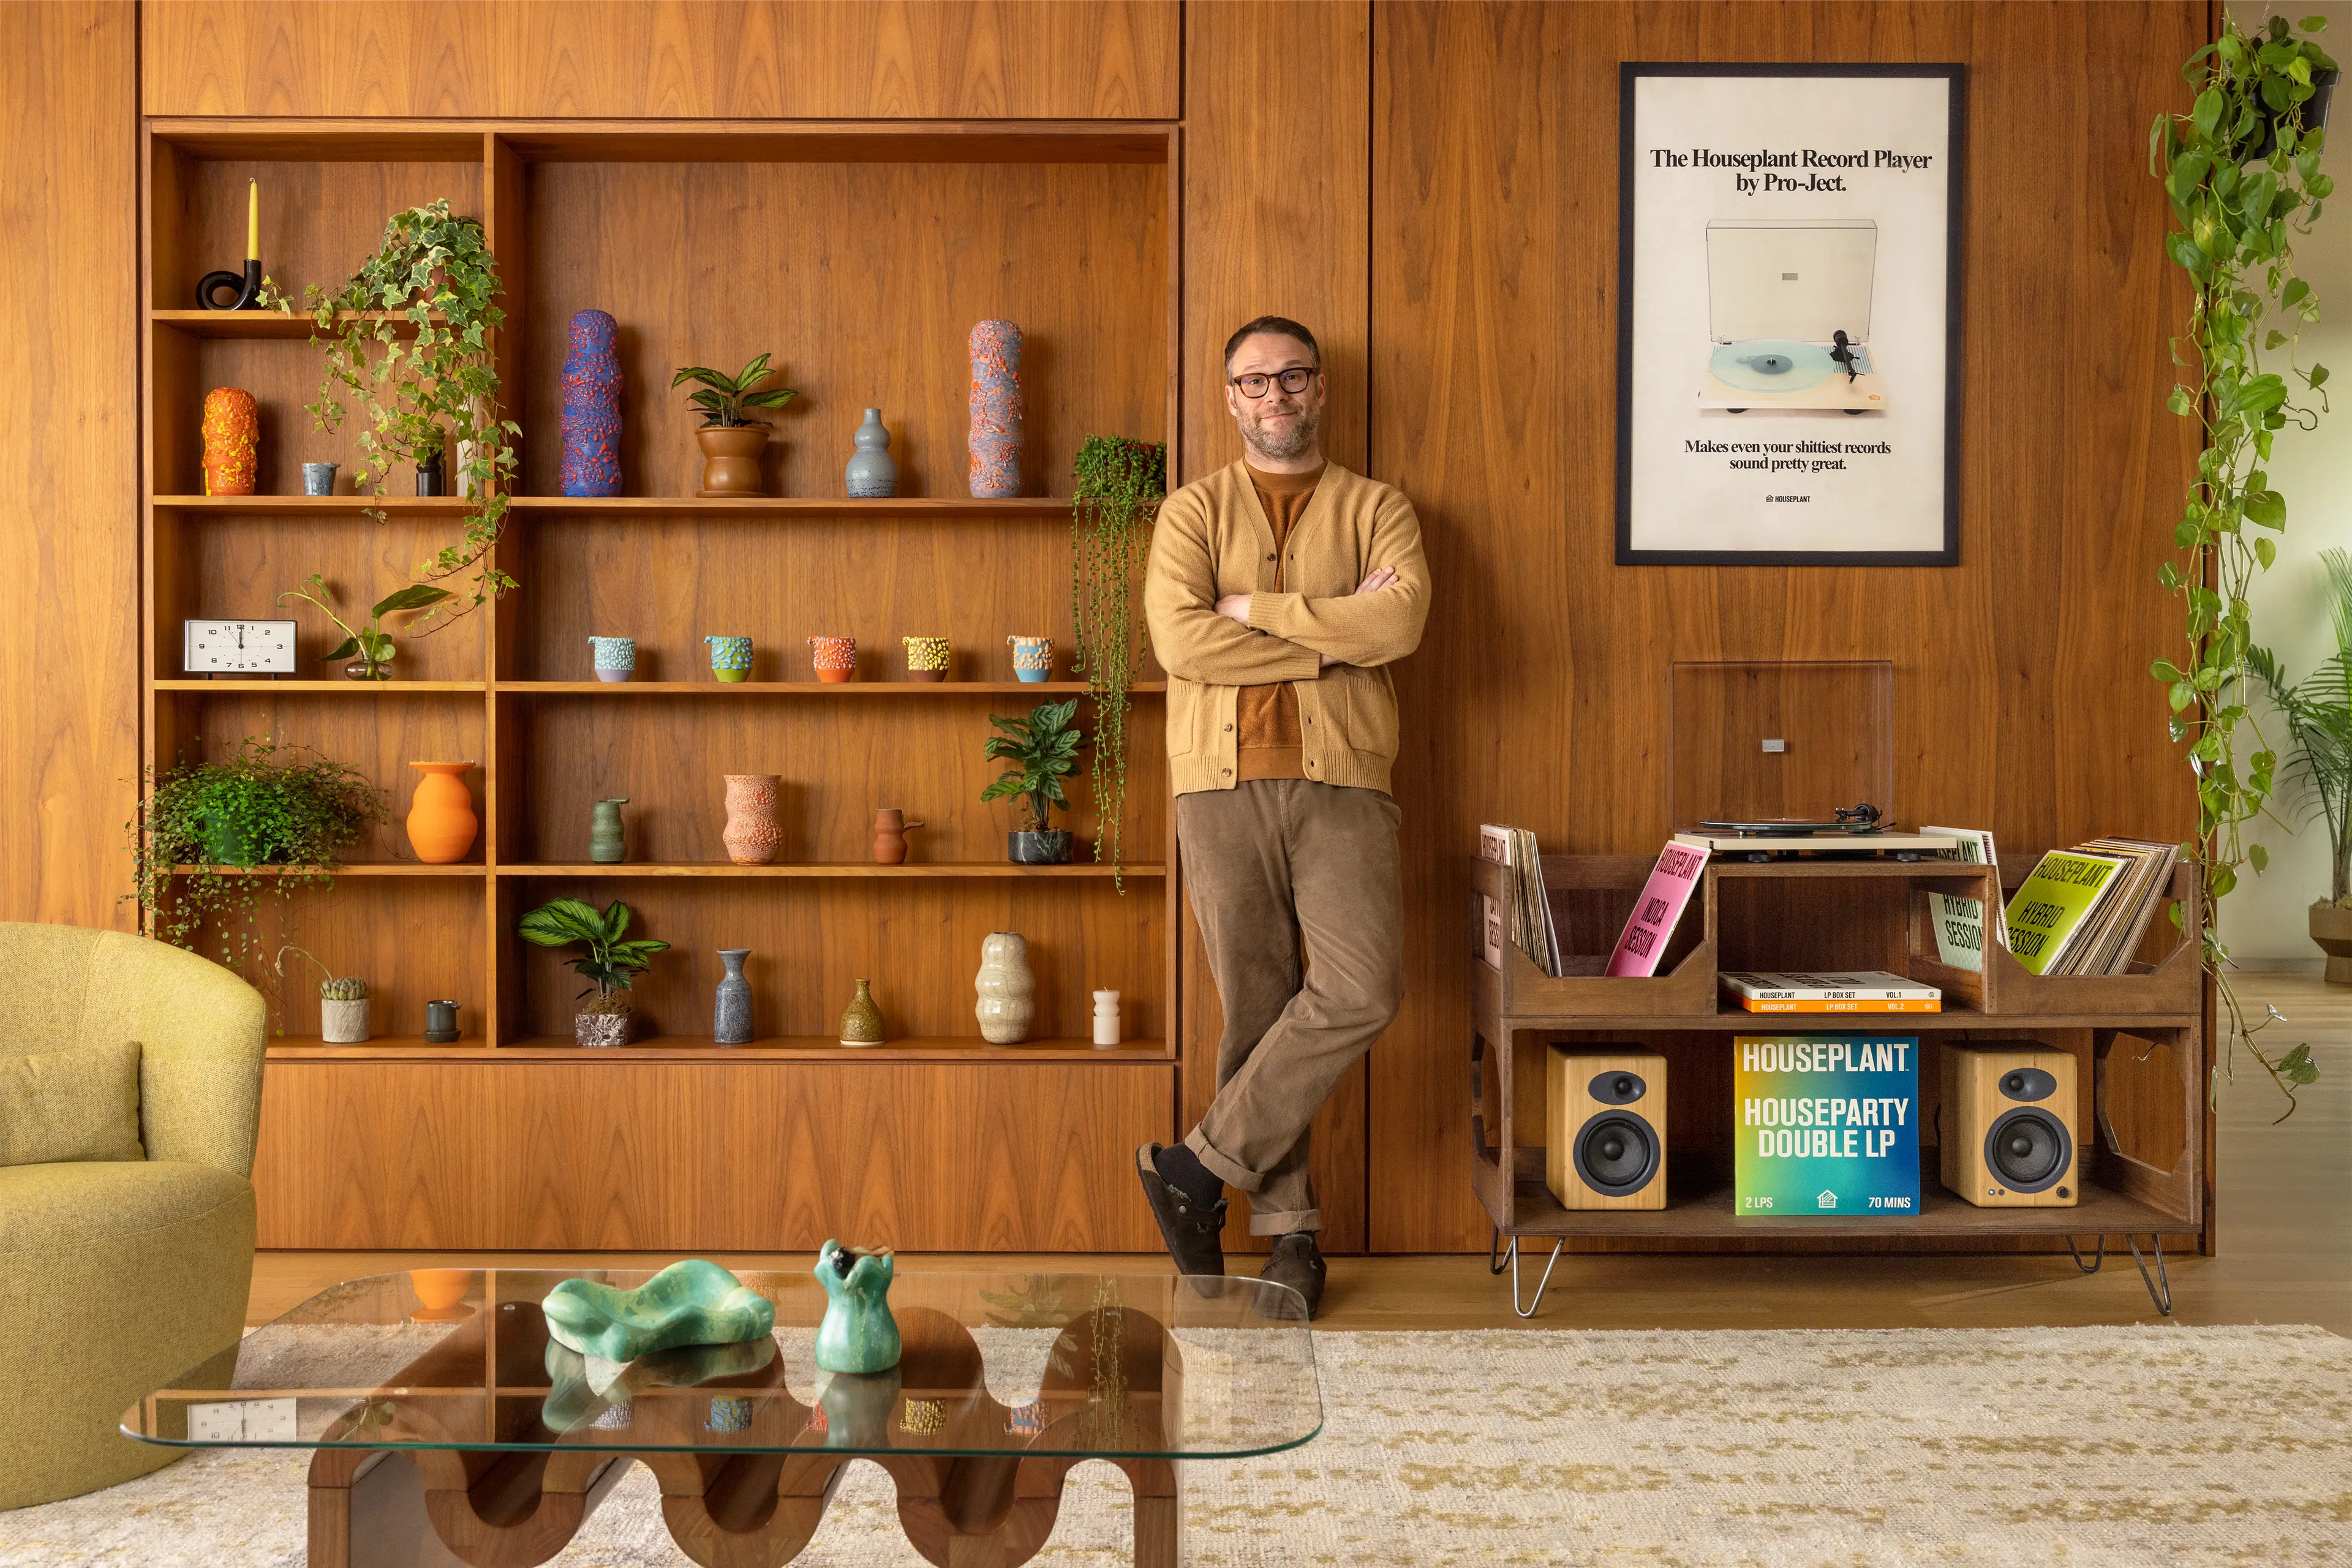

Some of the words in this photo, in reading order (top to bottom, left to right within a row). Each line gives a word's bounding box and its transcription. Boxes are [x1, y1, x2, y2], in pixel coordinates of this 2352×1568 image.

[1649, 149, 1688, 167] The
[1691, 149, 1798, 172] Houseplant
[1801, 149, 1869, 168] Record
[1874, 149, 1933, 173] Player
[1736, 173, 1760, 196] by
[1763, 173, 1847, 192] Pro-Ject.
[1685, 440, 1729, 453] Makes
[1731, 443, 1760, 453] even
[1762, 443, 1794, 459] your
[1795, 440, 1842, 454] shittiest
[1844, 441, 1891, 454] records
[1730, 455, 1769, 470] sound
[1771, 458, 1809, 473] pretty
[1811, 458, 1847, 473] great.
[1656, 848, 1703, 881] HOUSEPLANT
[2034, 857, 2114, 888] HOUSEPLANT
[1641, 897, 1670, 927] INDICA
[1943, 894, 1979, 919] HYBRID
[2017, 900, 2065, 929] HYBRID
[1624, 925, 1657, 959] SESSION
[1743, 1044, 1909, 1072] HOUSEPLANT
[1744, 1098, 1909, 1126] HOUSEPARTY
[1758, 1129, 1858, 1158] DOUBLE
[1866, 1129, 1895, 1158] LP
[1745, 1197, 1752, 1208] 2
[1754, 1197, 1773, 1208] LPS
[1868, 1197, 1882, 1208] 70
[1885, 1197, 1911, 1208] MINS
